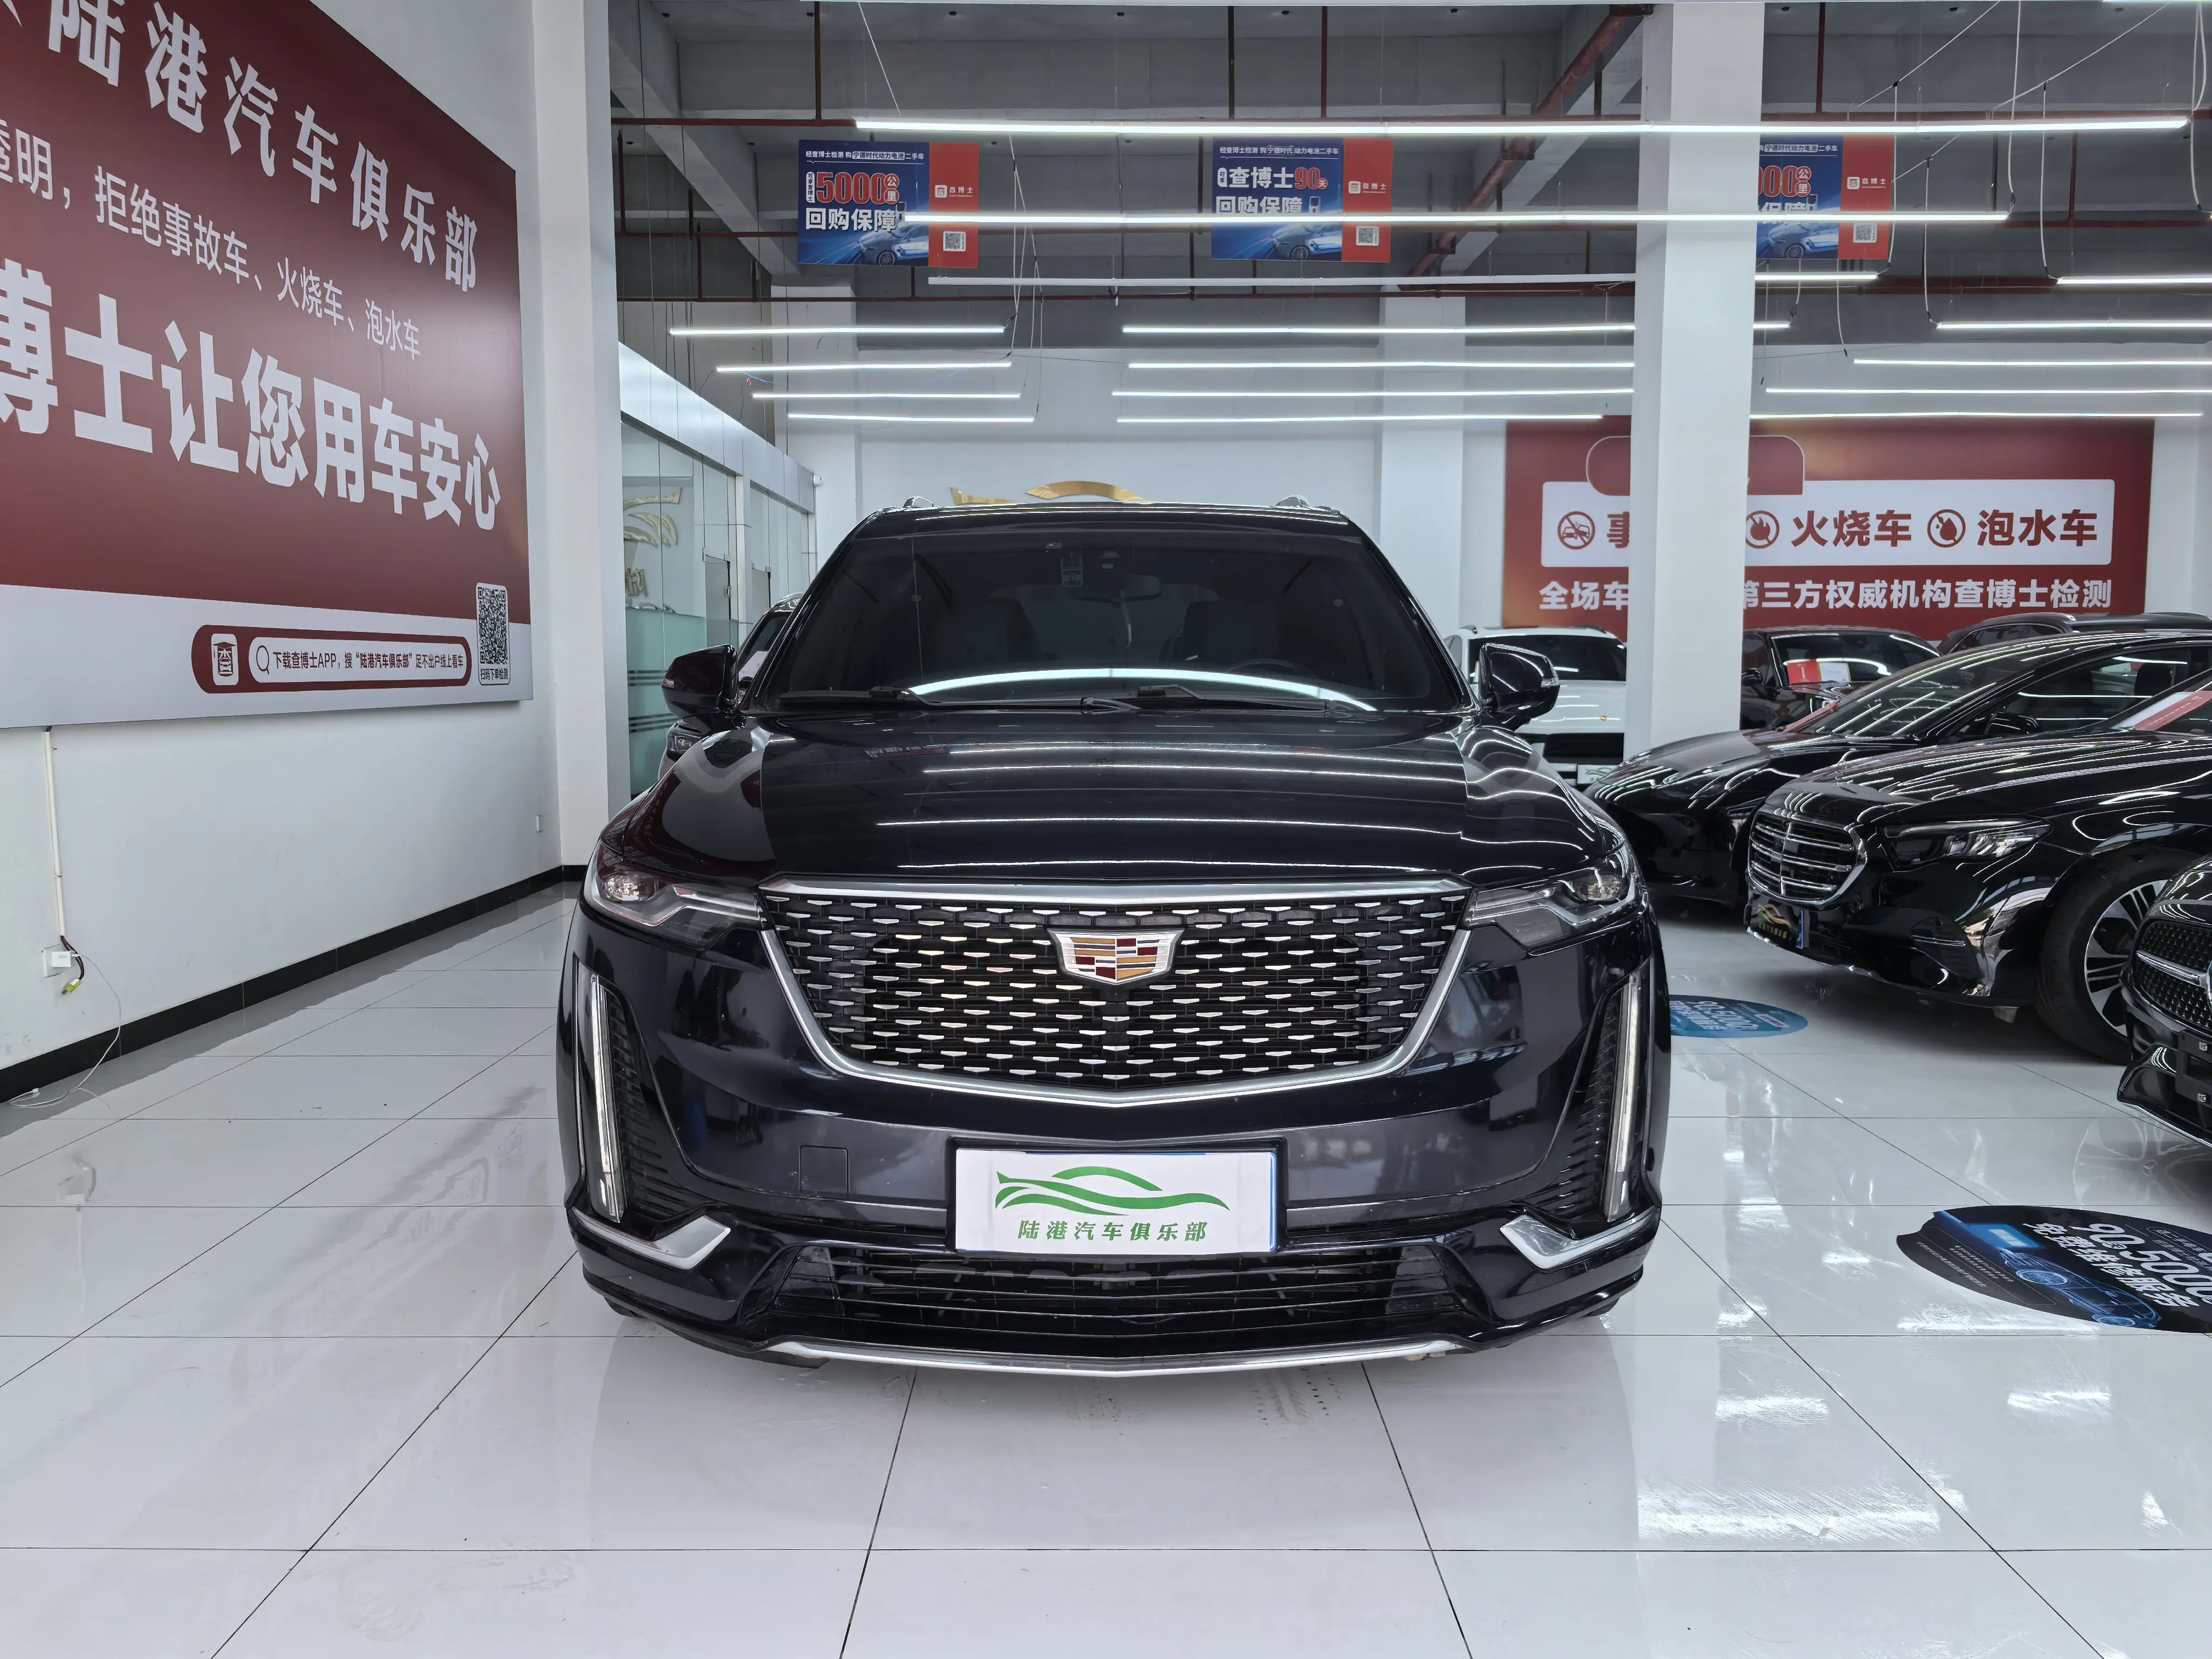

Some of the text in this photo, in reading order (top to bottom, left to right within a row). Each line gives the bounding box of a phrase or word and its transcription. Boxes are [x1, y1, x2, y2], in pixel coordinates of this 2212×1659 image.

[49, 0, 478, 292] 陆港汽车俱乐部
[1758, 165, 1811, 197] 00公里
[806, 208, 896, 232] 回购保障
[1216, 197, 1303, 214] 回购保障
[1791, 510, 1912, 547] 火烧车
[1977, 508, 2098, 547] 泡水车
[1539, 579, 2112, 610] 全场车 第三方权威机构查博士检测
[1018, 1219, 1209, 1242] 陆港汽车俱乐部
[2022, 1223, 2199, 1307] 免费维修服务
